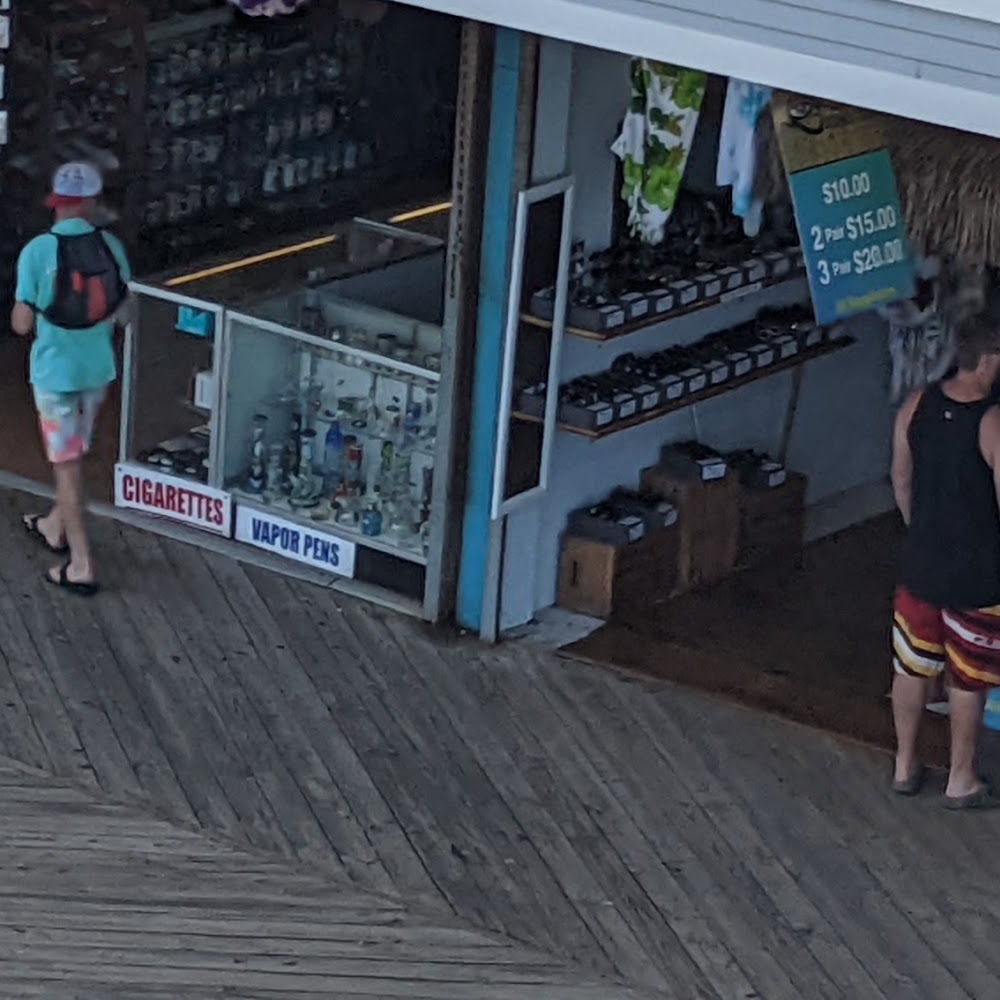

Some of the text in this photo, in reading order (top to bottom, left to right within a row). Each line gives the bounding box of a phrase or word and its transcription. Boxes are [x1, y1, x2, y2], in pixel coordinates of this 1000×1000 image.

[822, 172, 871, 204] $10.00
[811, 225, 825, 251] 2
[846, 205, 896, 240] $15.00
[817, 260, 830, 285] 3
[122, 474, 224, 526] CIGARETTES
[252, 517, 340, 567] VAPOR PENS
